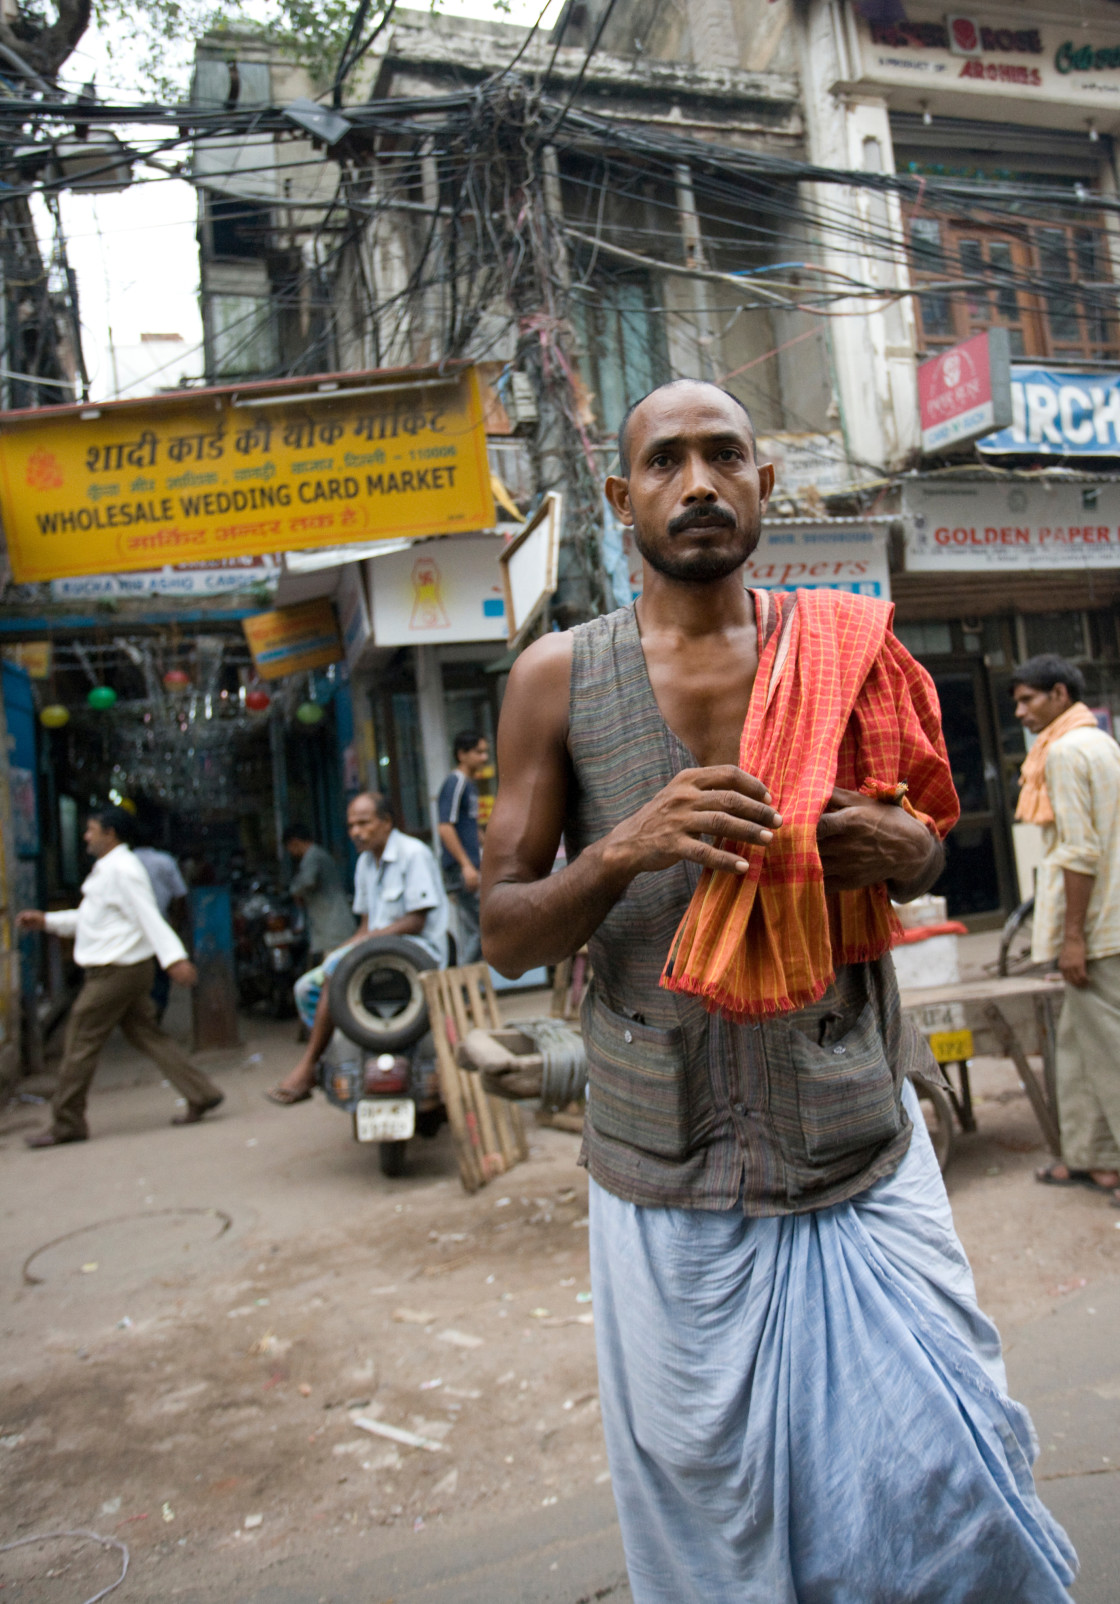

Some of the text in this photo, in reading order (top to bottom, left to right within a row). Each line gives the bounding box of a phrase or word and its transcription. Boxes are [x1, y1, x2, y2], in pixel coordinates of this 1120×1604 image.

[959, 59, 1041, 87] ARCHIES
[86, 428, 160, 472] शादी
[167, 420, 227, 463] कार्ड
[36, 466, 458, 535] WHOLESALE WEDDING CARD MARKET
[934, 527, 1030, 546] GOLDEN
[1038, 526, 1110, 544] PAPER
